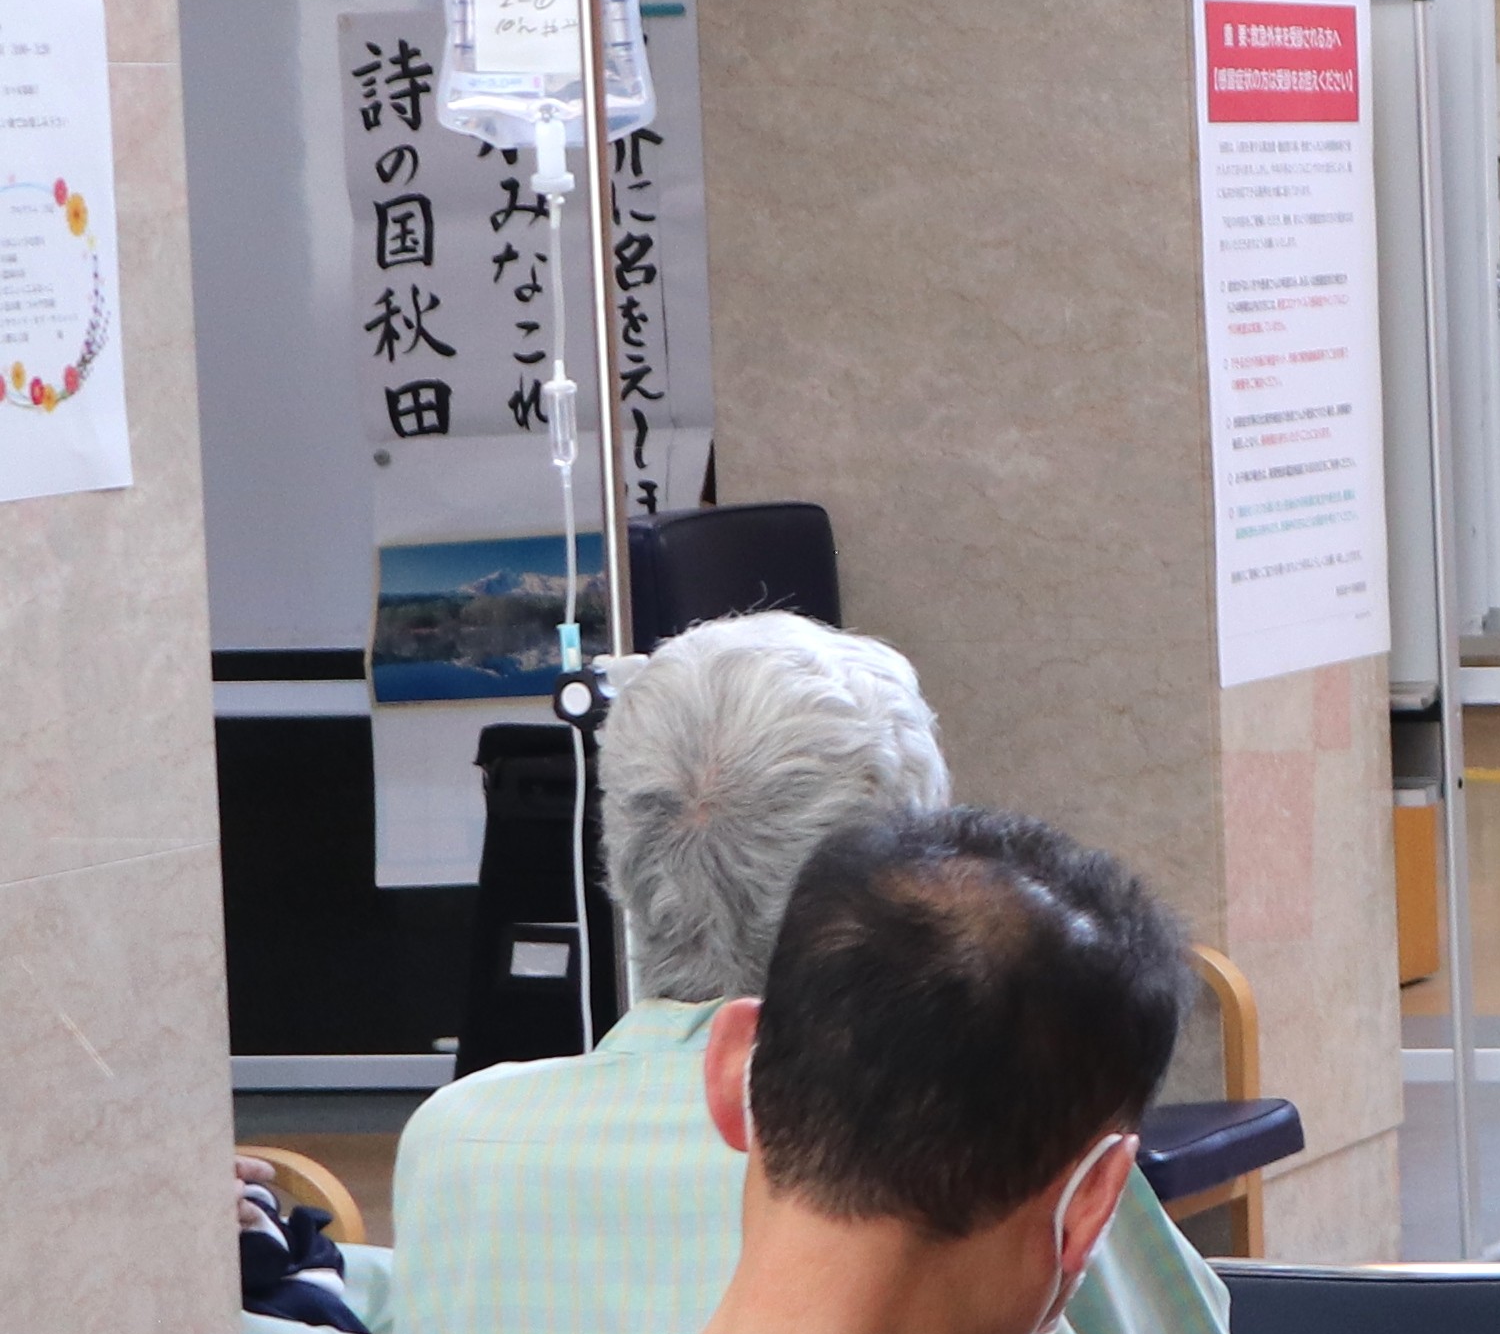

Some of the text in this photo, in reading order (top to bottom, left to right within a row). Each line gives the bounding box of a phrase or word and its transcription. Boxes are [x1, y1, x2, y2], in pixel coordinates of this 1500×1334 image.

[352, 39, 457, 438] 詩の国秋田
